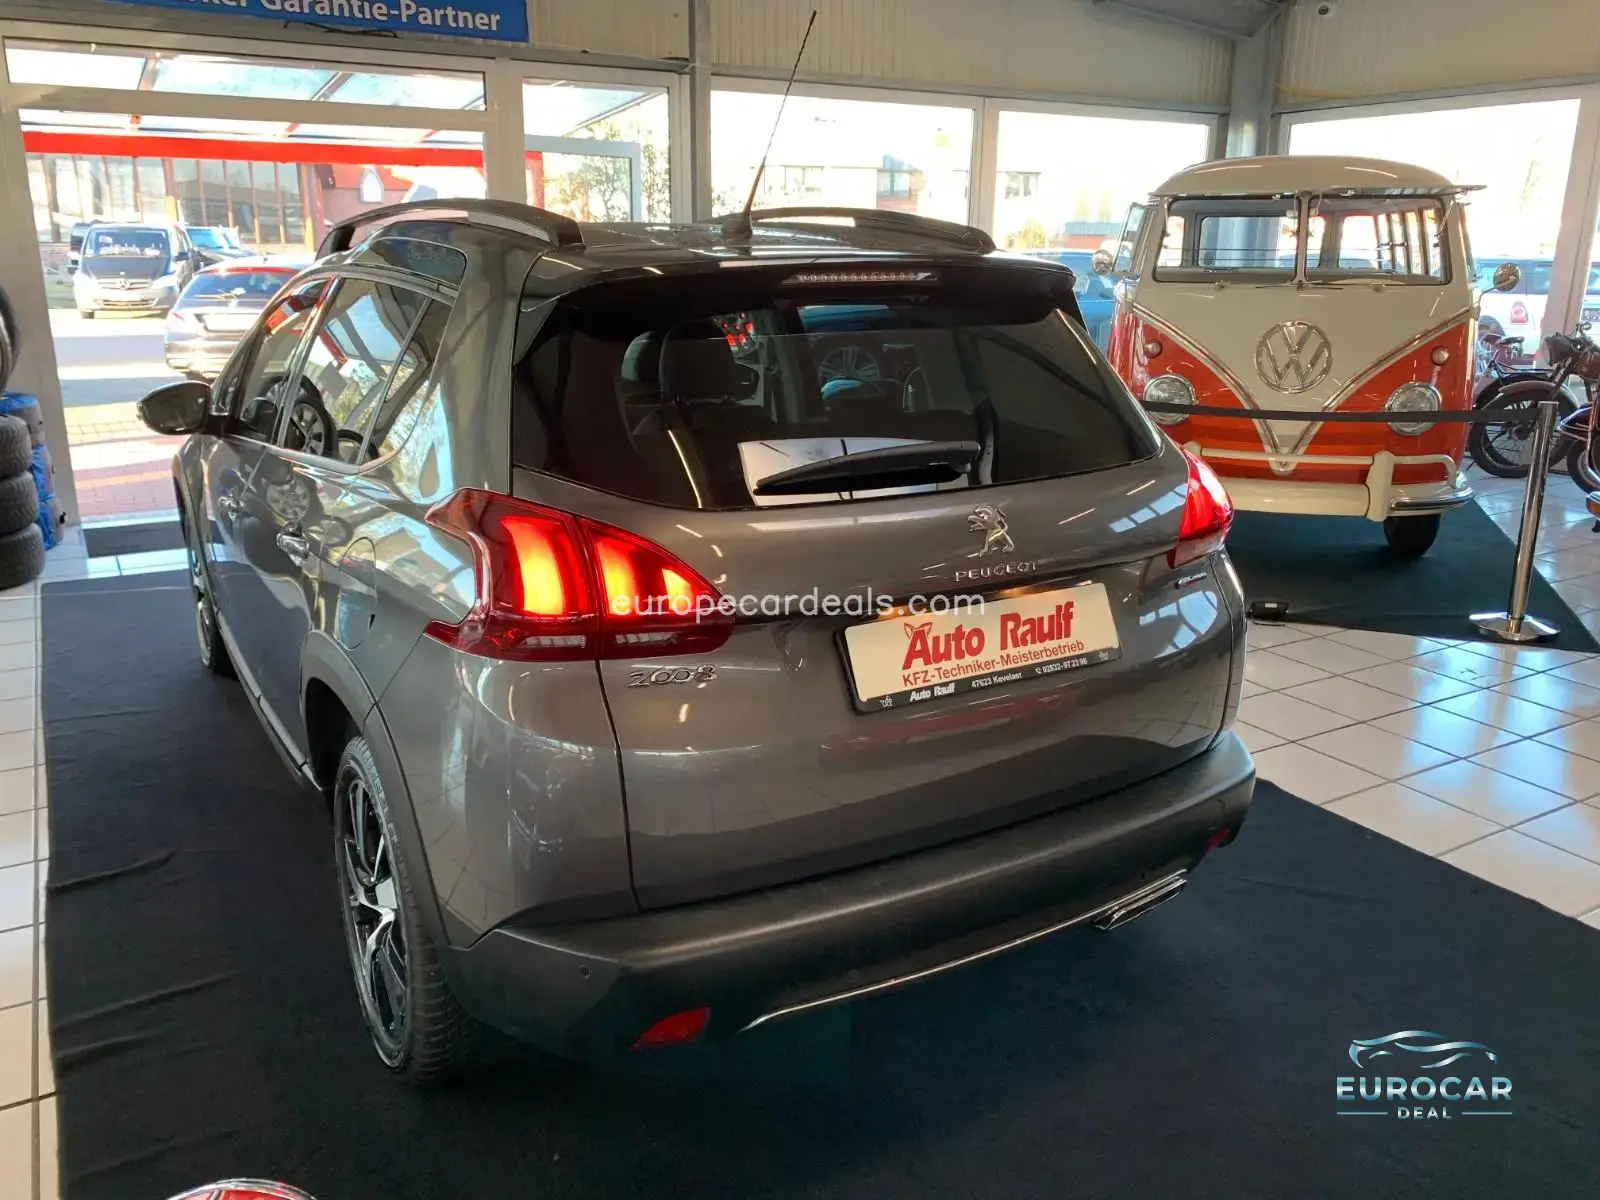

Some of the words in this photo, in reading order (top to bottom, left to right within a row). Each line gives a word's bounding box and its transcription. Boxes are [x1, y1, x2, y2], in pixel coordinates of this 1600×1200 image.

[954, 560, 1037, 582] PEUGEOT
[902, 623, 985, 670] Auto
[1000, 601, 1075, 651] Raulf
[628, 663, 717, 688] 2008
[903, 640, 1085, 687] KFZ-Techniker-Meisterbetrieb
[909, 690, 931, 702] Auto
[971, 677, 992, 688] 47623
[993, 672, 1023, 685] Kevelaer
